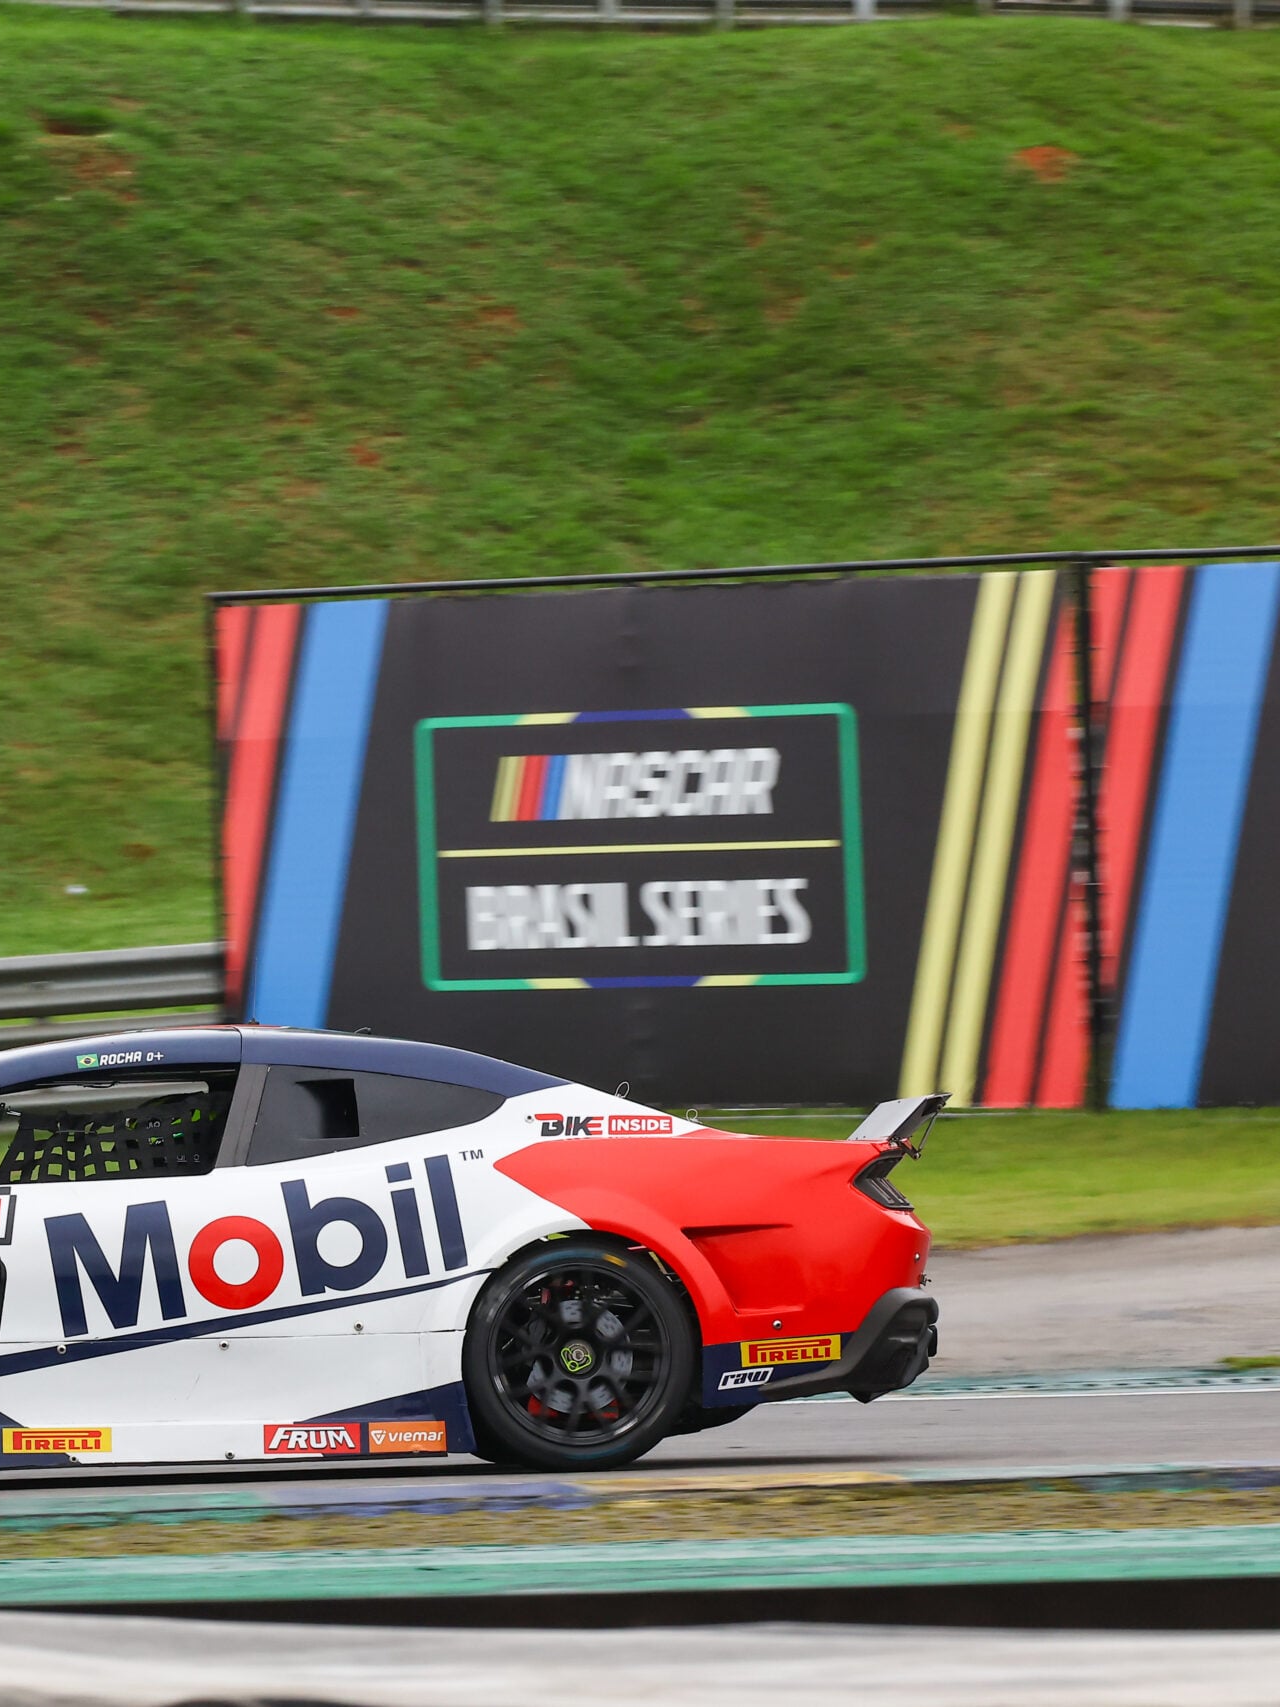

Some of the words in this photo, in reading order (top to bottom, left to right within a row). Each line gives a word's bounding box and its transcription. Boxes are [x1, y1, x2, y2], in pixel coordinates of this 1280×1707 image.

[560, 748, 781, 821] NASCAR
[466, 882, 639, 950] BRASIL
[640, 878, 812, 947] SERIES
[100, 1051, 142, 1066] ROCHA
[534, 1113, 604, 1137] BIKE
[611, 1118, 670, 1132] INSIDE
[44, 1154, 468, 1337] Mobil
[748, 1338, 832, 1364] PIRELLI
[721, 1370, 770, 1387] raw
[12, 1430, 102, 1451] PIRELLI
[271, 1426, 356, 1450] FRUM
